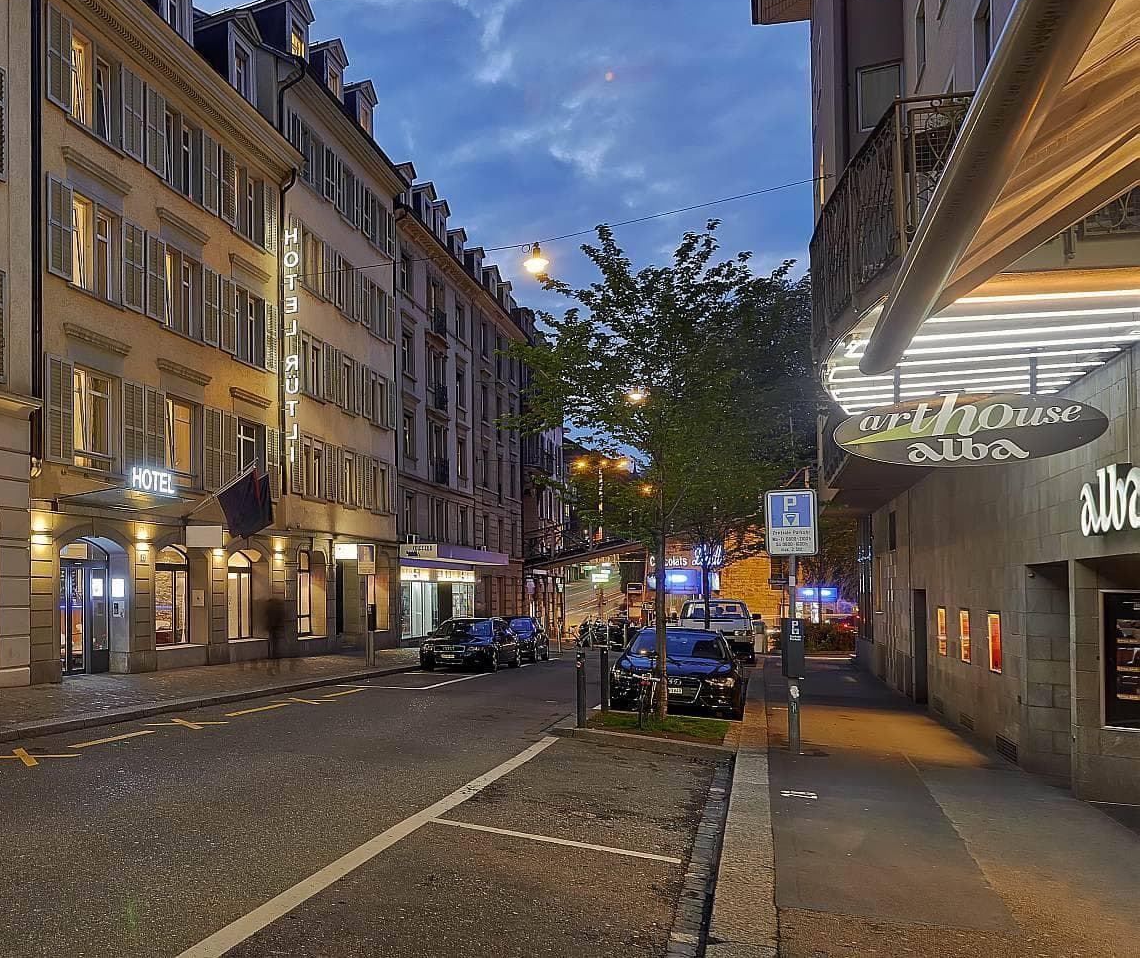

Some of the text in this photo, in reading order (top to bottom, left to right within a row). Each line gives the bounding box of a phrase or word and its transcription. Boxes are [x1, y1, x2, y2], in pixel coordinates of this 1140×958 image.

[907, 437, 1030, 463] alba
[132, 466, 175, 494] HOTEL
[650, 555, 688, 567] Ccolats
